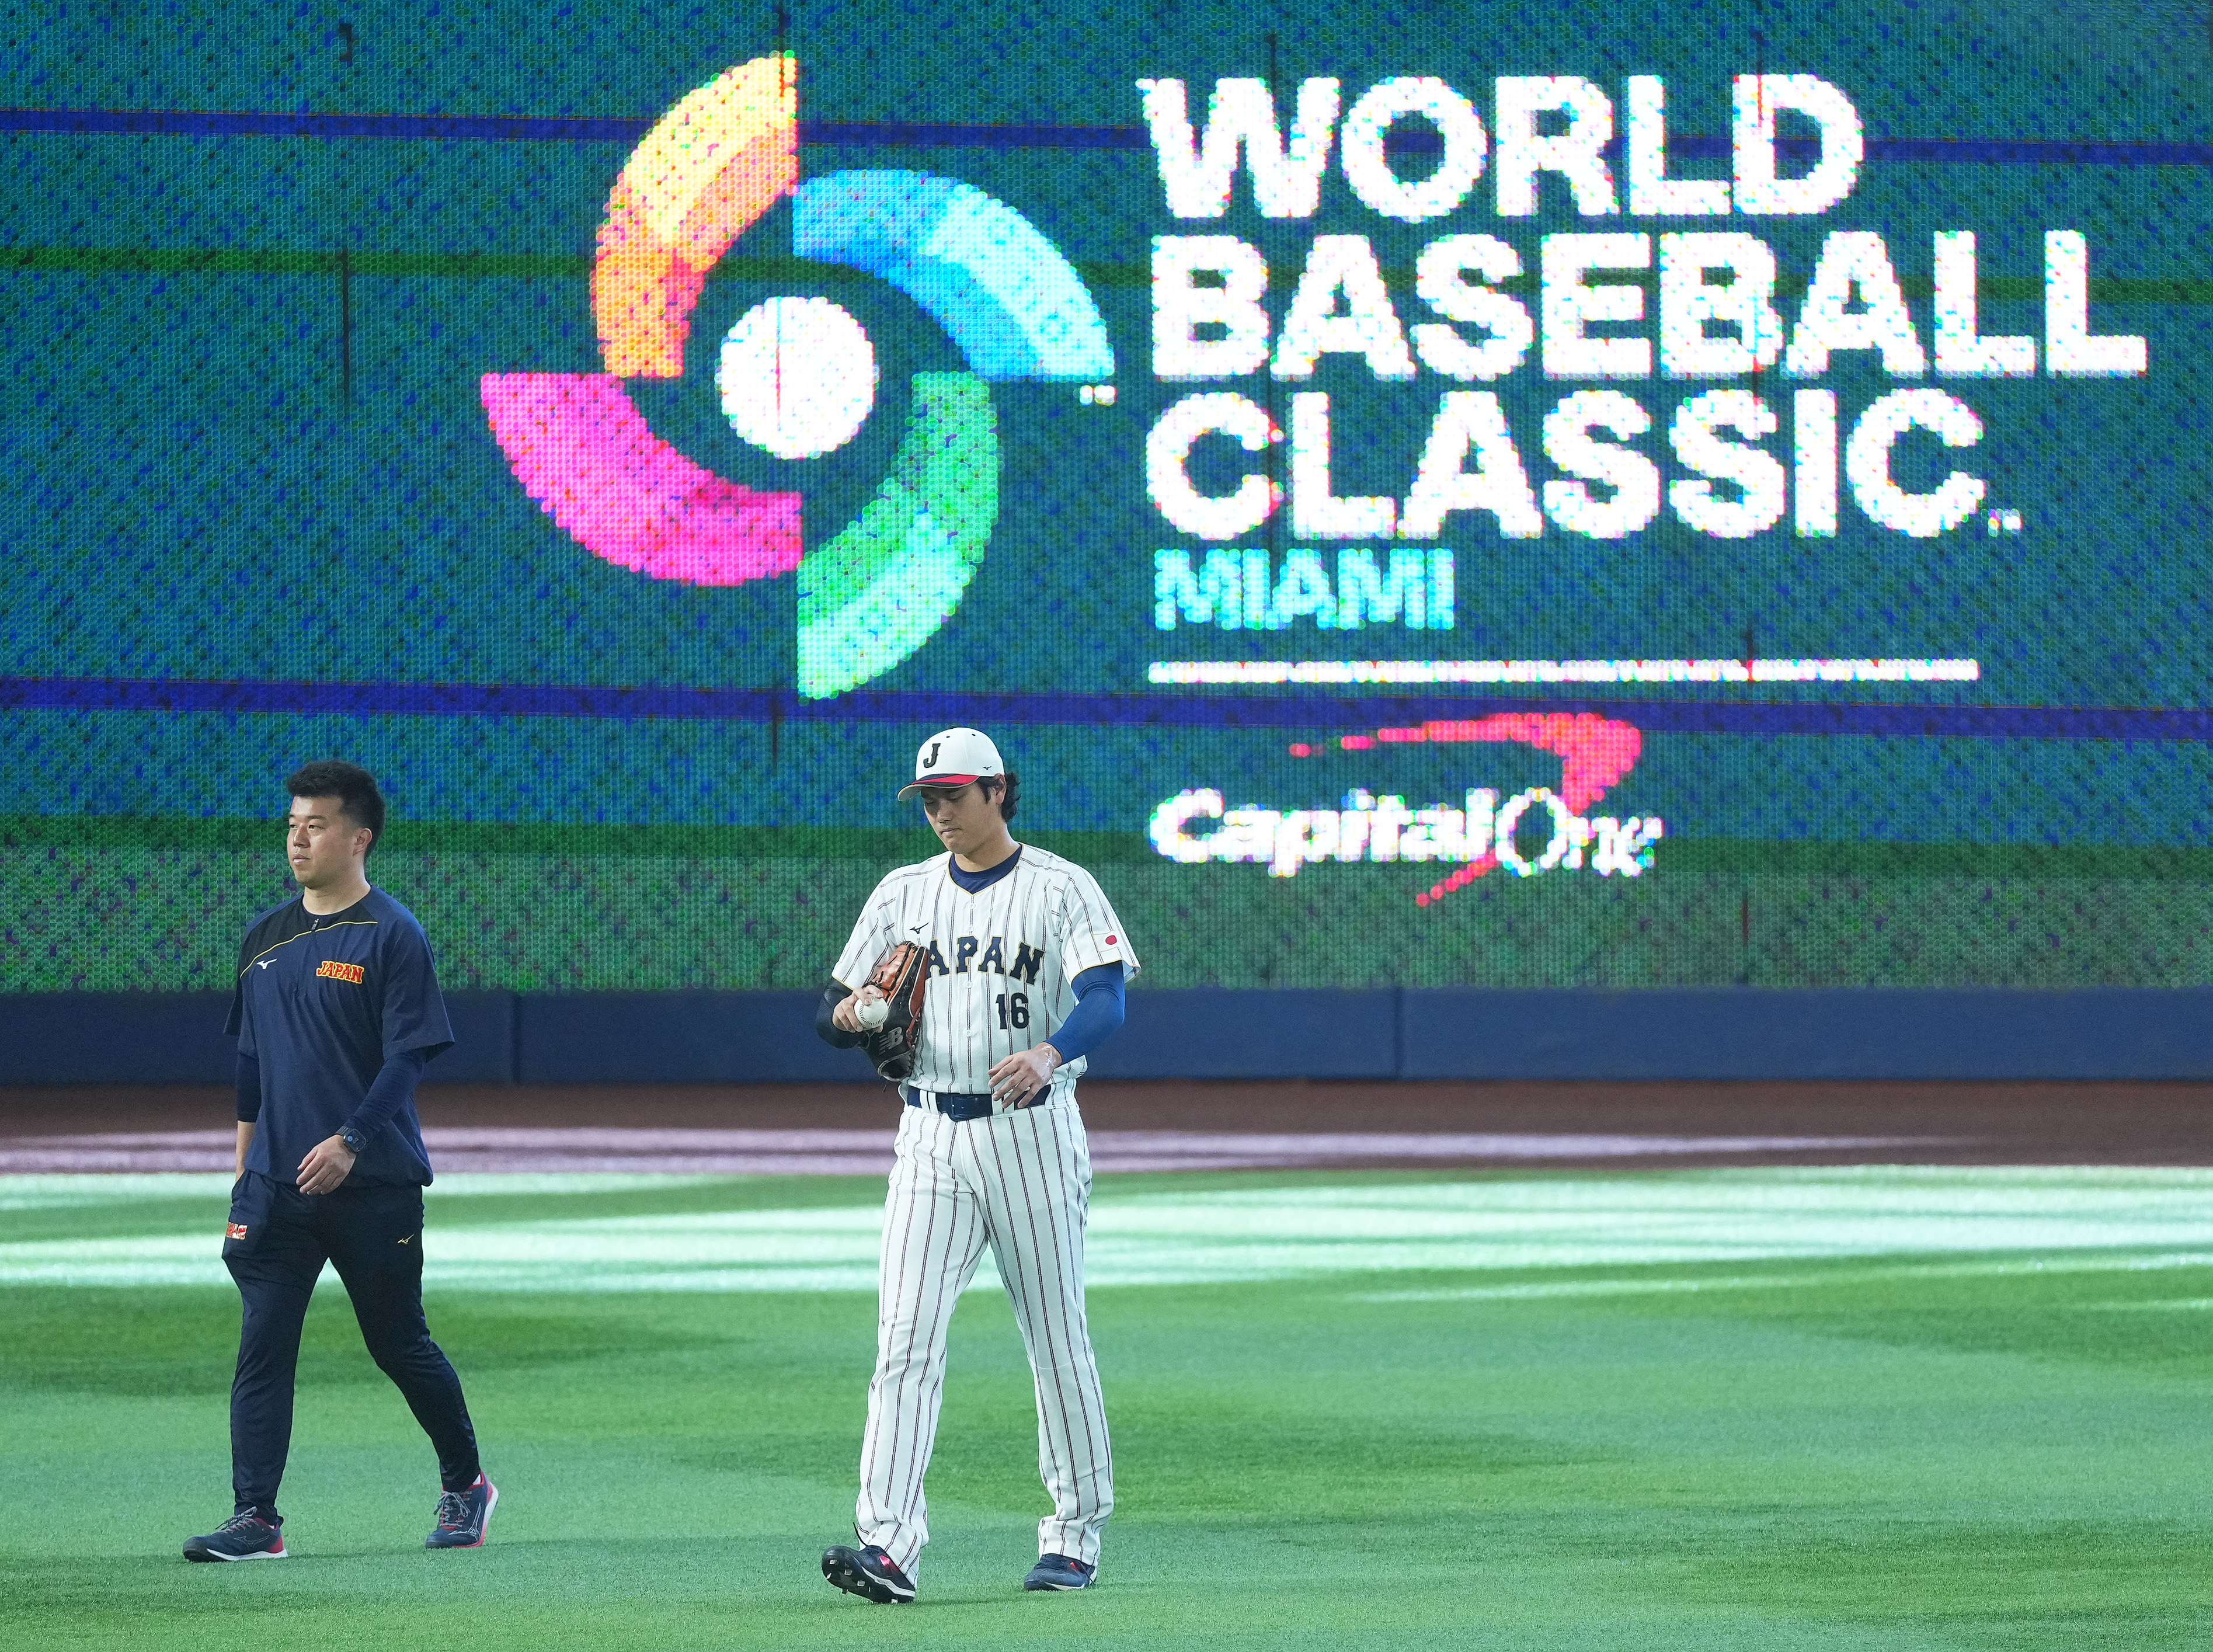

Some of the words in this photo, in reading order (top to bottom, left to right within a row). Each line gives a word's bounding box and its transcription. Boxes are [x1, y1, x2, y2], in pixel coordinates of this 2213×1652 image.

[1136, 75, 1864, 221] WORLD
[1151, 231, 2147, 380] BASEBALL
[1146, 389, 1984, 539] CLASSIC
[1154, 549, 1454, 630] MIAMI
[923, 743, 941, 768] J
[316, 961, 364, 984] JAPAN
[925, 935, 1045, 986] APAN
[996, 992, 1030, 1030] 16
